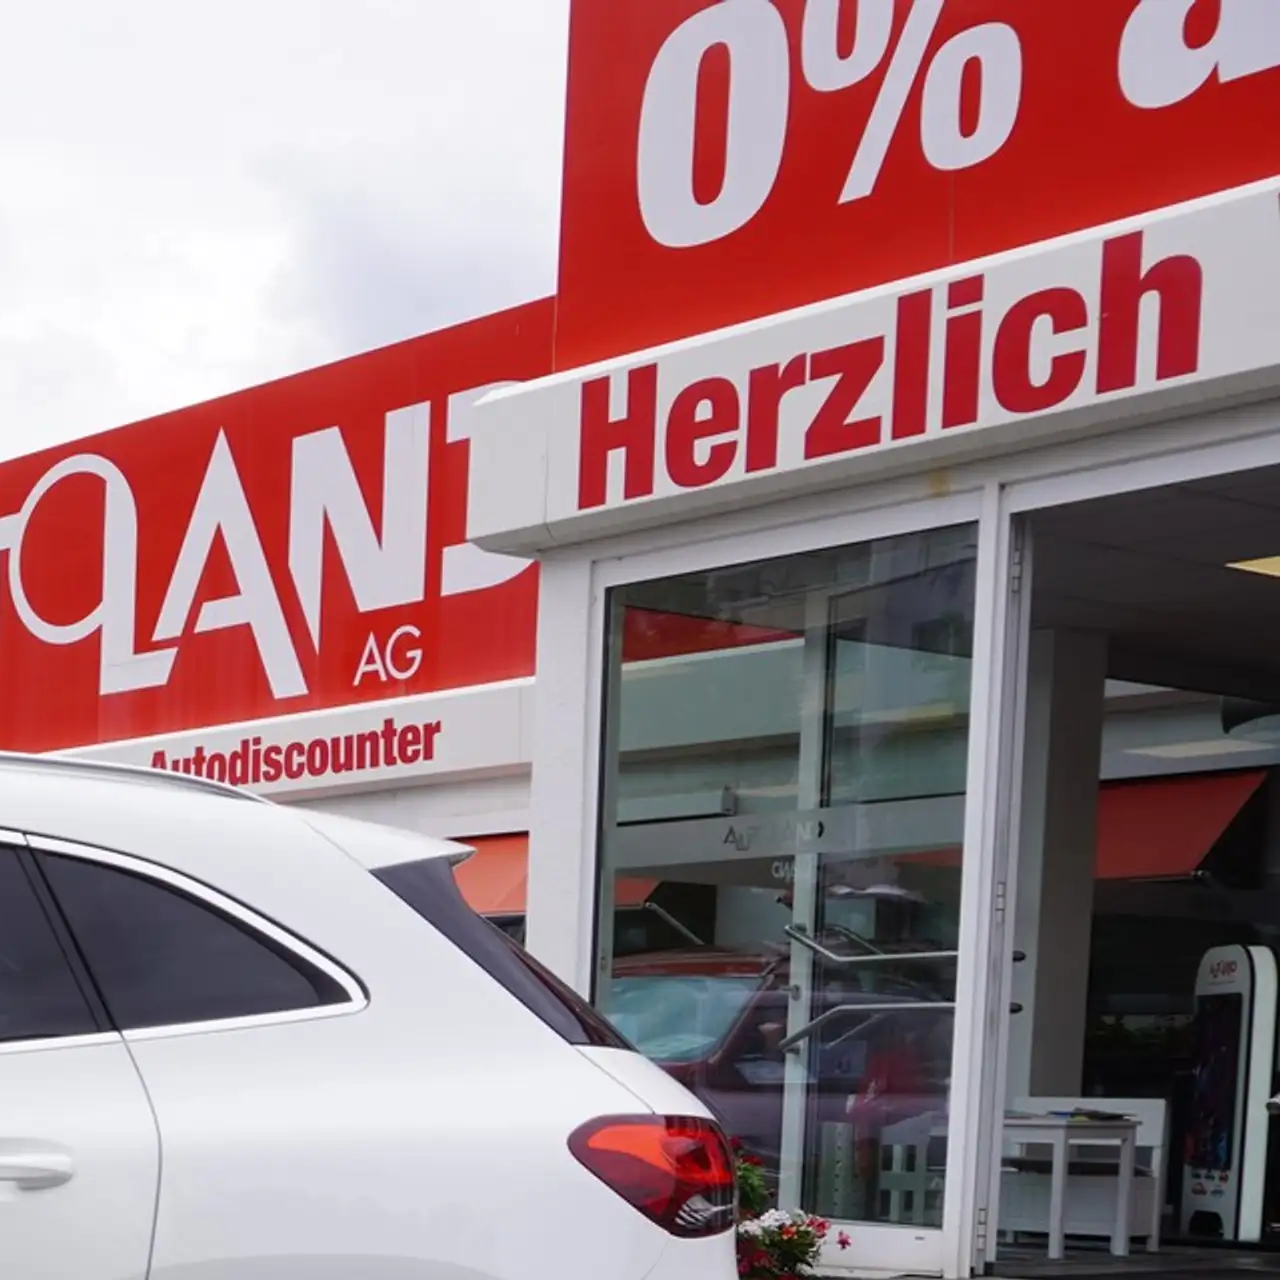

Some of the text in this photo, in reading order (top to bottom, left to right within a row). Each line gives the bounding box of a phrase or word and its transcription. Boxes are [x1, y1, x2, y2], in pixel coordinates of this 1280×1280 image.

[636, 0, 1022, 248] 0%
[578, 229, 1204, 510] Herzlich
[352, 624, 423, 686] AG
